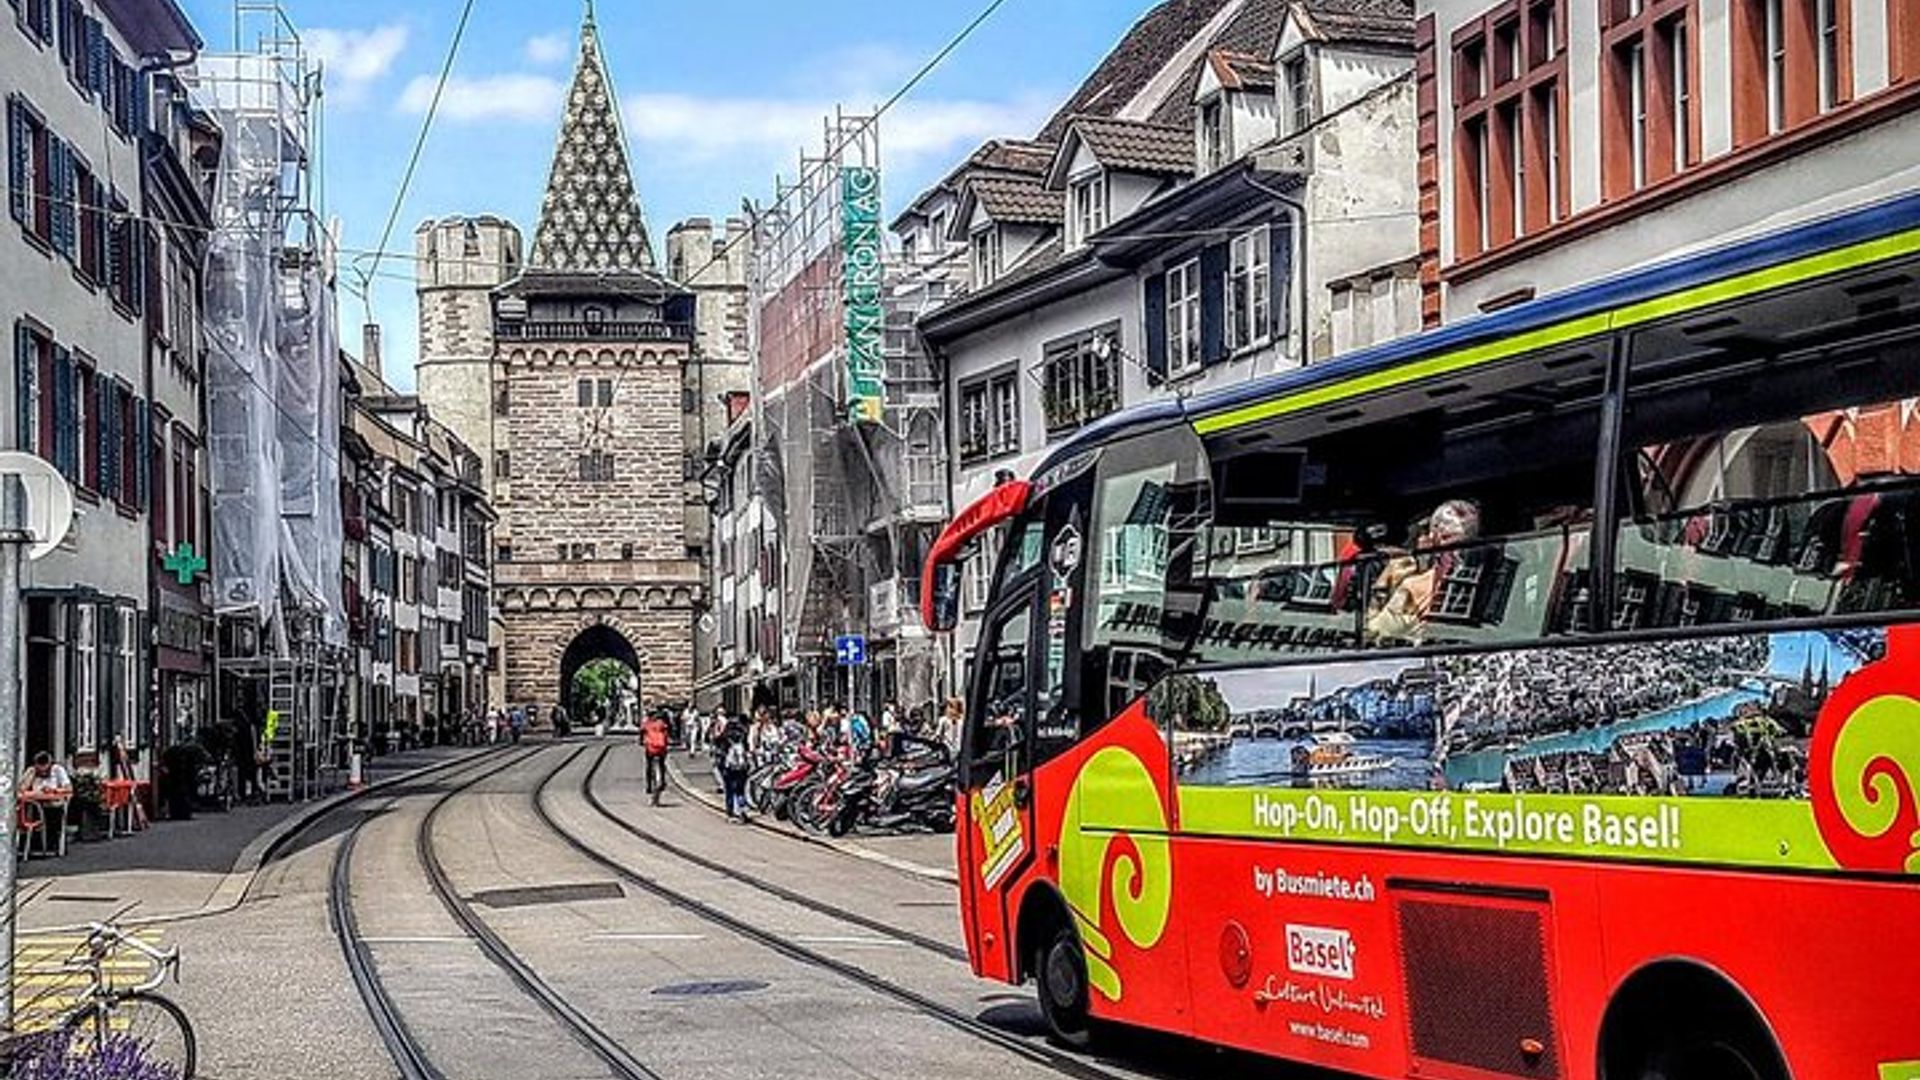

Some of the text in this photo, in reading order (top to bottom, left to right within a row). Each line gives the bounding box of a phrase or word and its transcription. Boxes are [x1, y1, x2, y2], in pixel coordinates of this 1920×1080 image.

[849, 168, 884, 386] JEAN CRON AG
[1254, 794, 1680, 848] Hop-On, Hop-Off, Explore Basel!
[1254, 865, 1375, 901] by Busmiete.ch
[1290, 931, 1349, 972] Basel
[1256, 974, 1386, 1019] Culture Unlimited
[1289, 1020, 1371, 1048] www.basel.com
